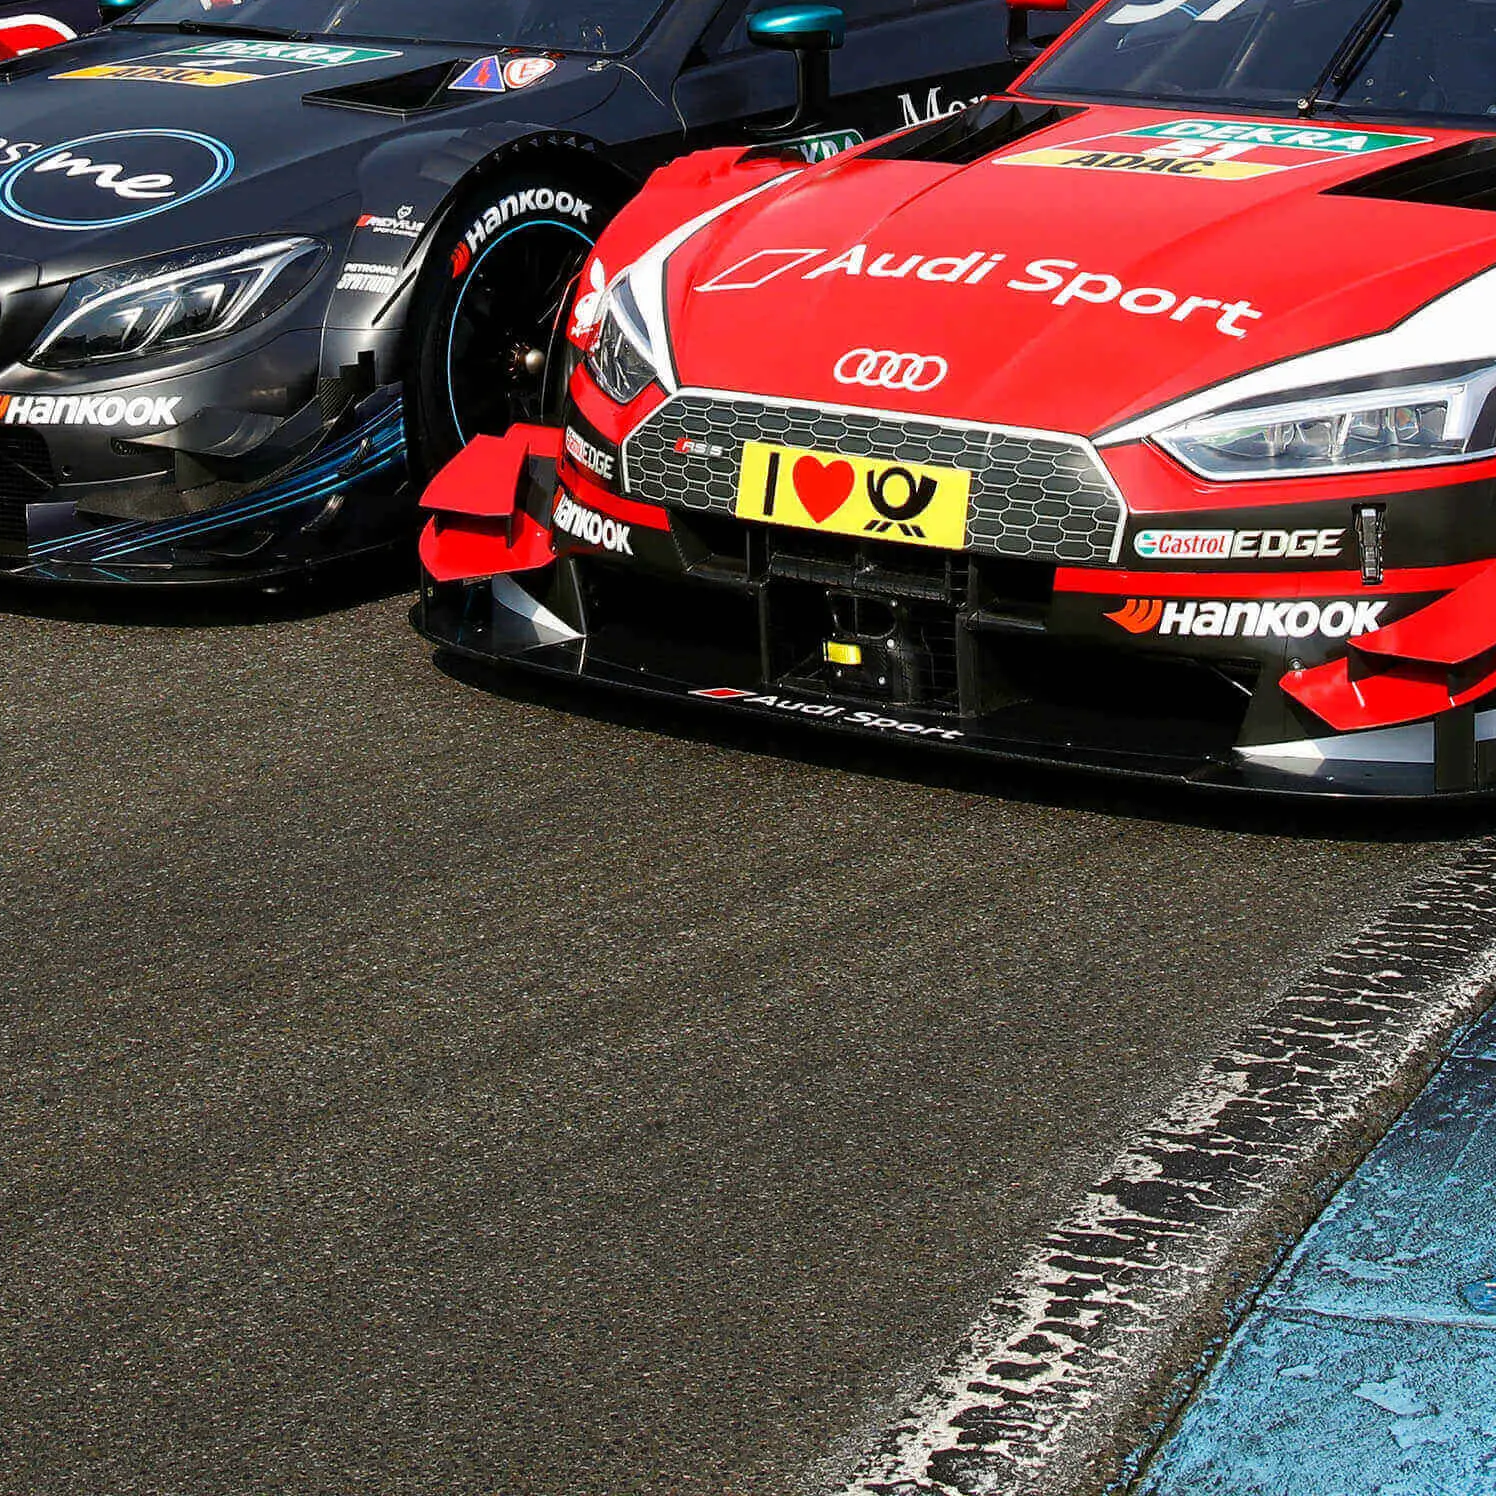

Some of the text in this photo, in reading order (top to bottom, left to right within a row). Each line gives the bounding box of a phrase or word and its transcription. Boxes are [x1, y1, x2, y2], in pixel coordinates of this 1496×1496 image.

[1141, 139, 1249, 160] 51
[1159, 121, 1371, 150] DEKRA
[33, 150, 178, 200] me
[1061, 153, 1216, 174] ADAC
[343, 262, 400, 276] PETRONAS
[801, 243, 1264, 339] Audi Sport
[583, 443, 615, 481] EDGE
[1158, 529, 1347, 559] Castrol EDGE
[743, 695, 965, 740] Audi Sport
